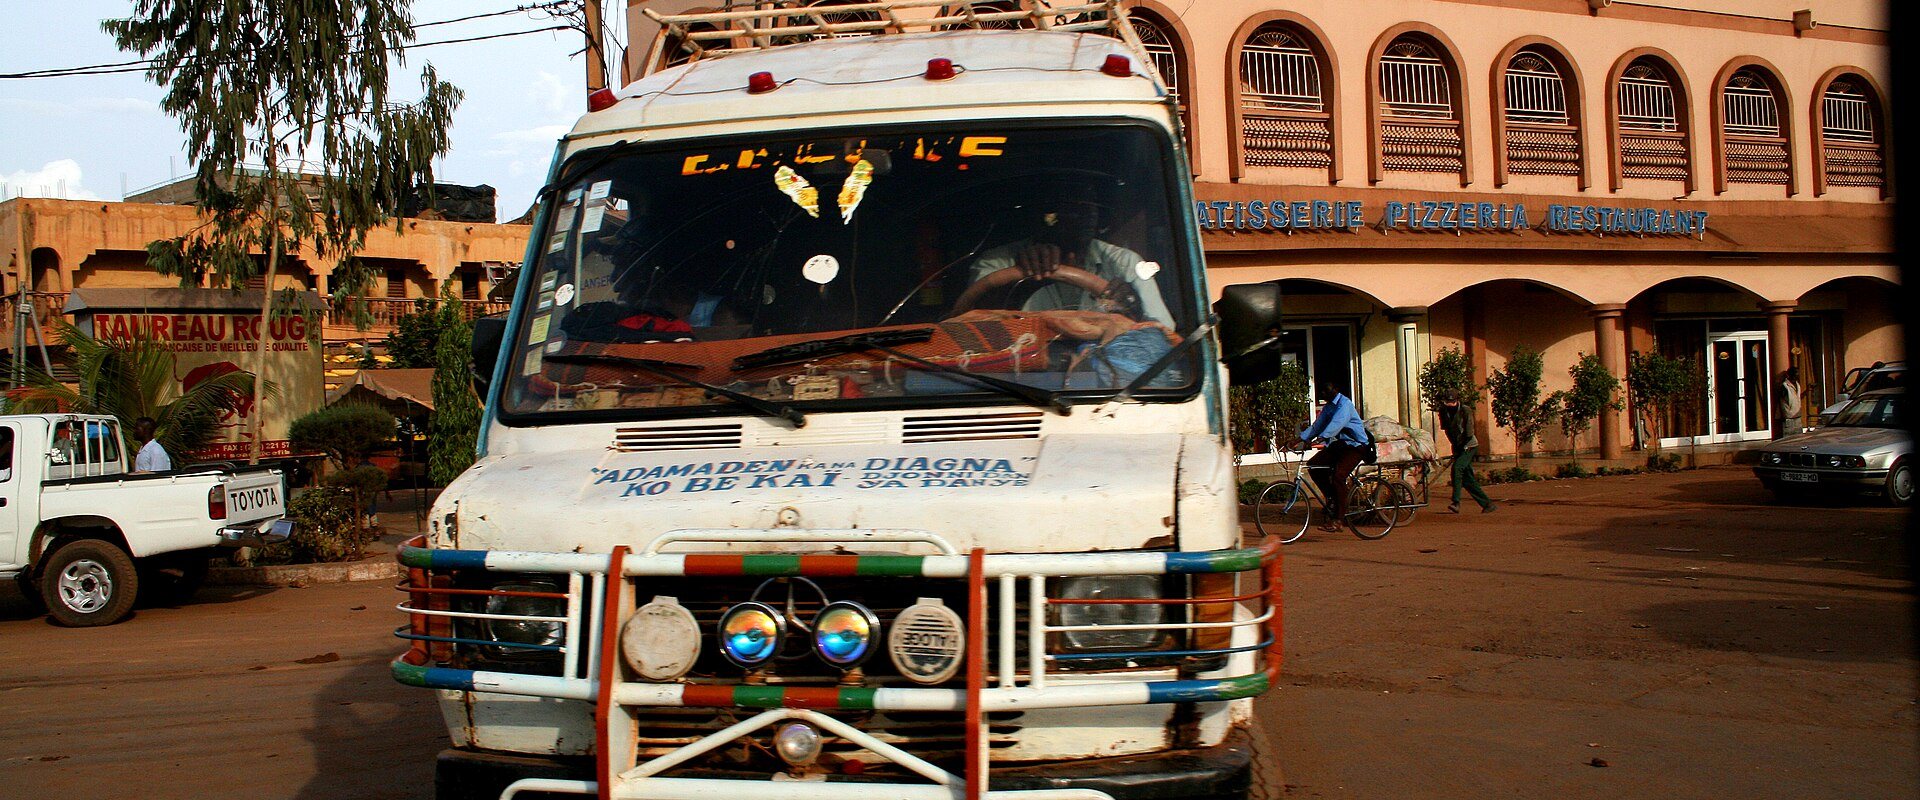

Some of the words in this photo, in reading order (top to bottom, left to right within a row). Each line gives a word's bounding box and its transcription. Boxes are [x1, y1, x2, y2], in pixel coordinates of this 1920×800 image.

[1196, 200, 1365, 230] ATISSERIE
[1386, 200, 1529, 230] PIZZERIA
[1549, 203, 1710, 234] RESTAURANT
[96, 314, 226, 342] TAUREAU
[233, 315, 318, 342] ROUG
[205, 342, 218, 352] DE
[220, 342, 270, 352] MEILLEUE
[223, 444, 238, 452] FAX
[619, 480, 671, 497] KO
[681, 476, 741, 493] BE
[230, 487, 278, 512] TOYOTA
